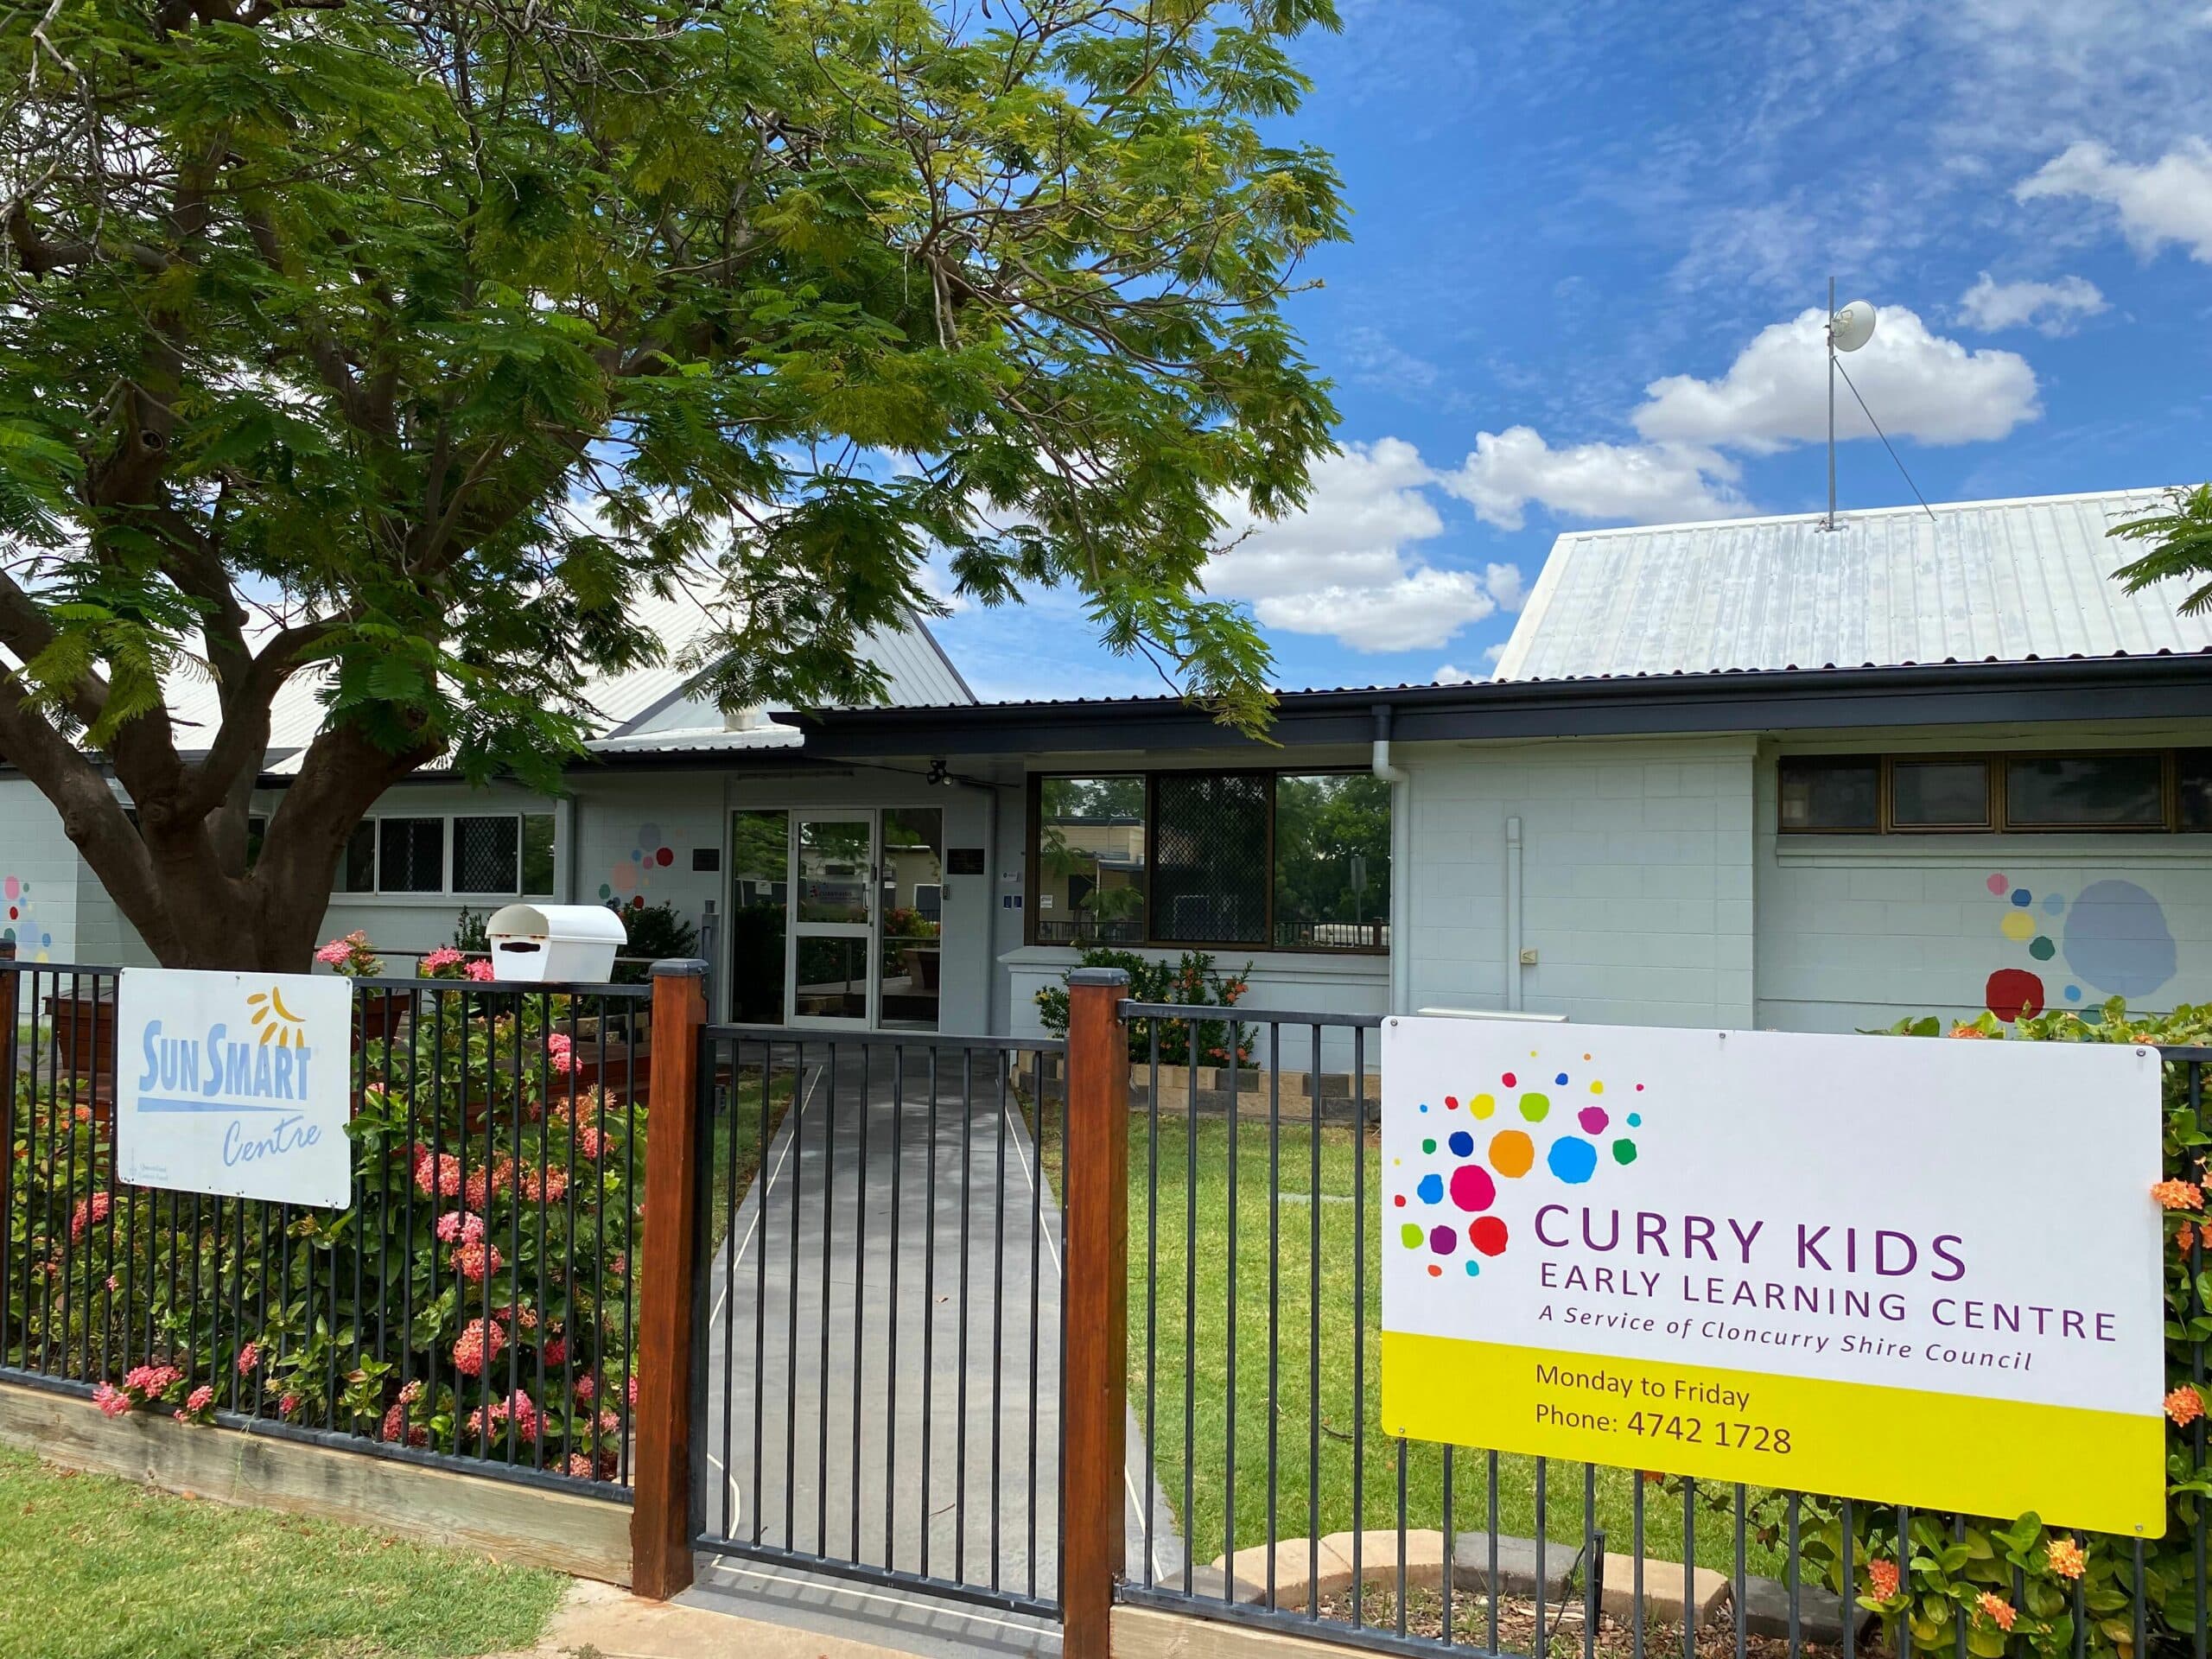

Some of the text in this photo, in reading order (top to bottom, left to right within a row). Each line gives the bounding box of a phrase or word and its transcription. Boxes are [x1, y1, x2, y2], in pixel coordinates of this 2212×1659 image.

[223, 1115, 321, 1167] Centre
[1535, 1204, 1966, 1281] CURRY KIDS
[1541, 1262, 2116, 1342] EARLY LEARNING CENTRE
[1538, 1305, 2031, 1371] A Service of Cloncurry Shire Council
[1536, 1363, 1750, 1412] Monday to Friday
[1536, 1403, 1791, 1454] Phone: 4742 1728
